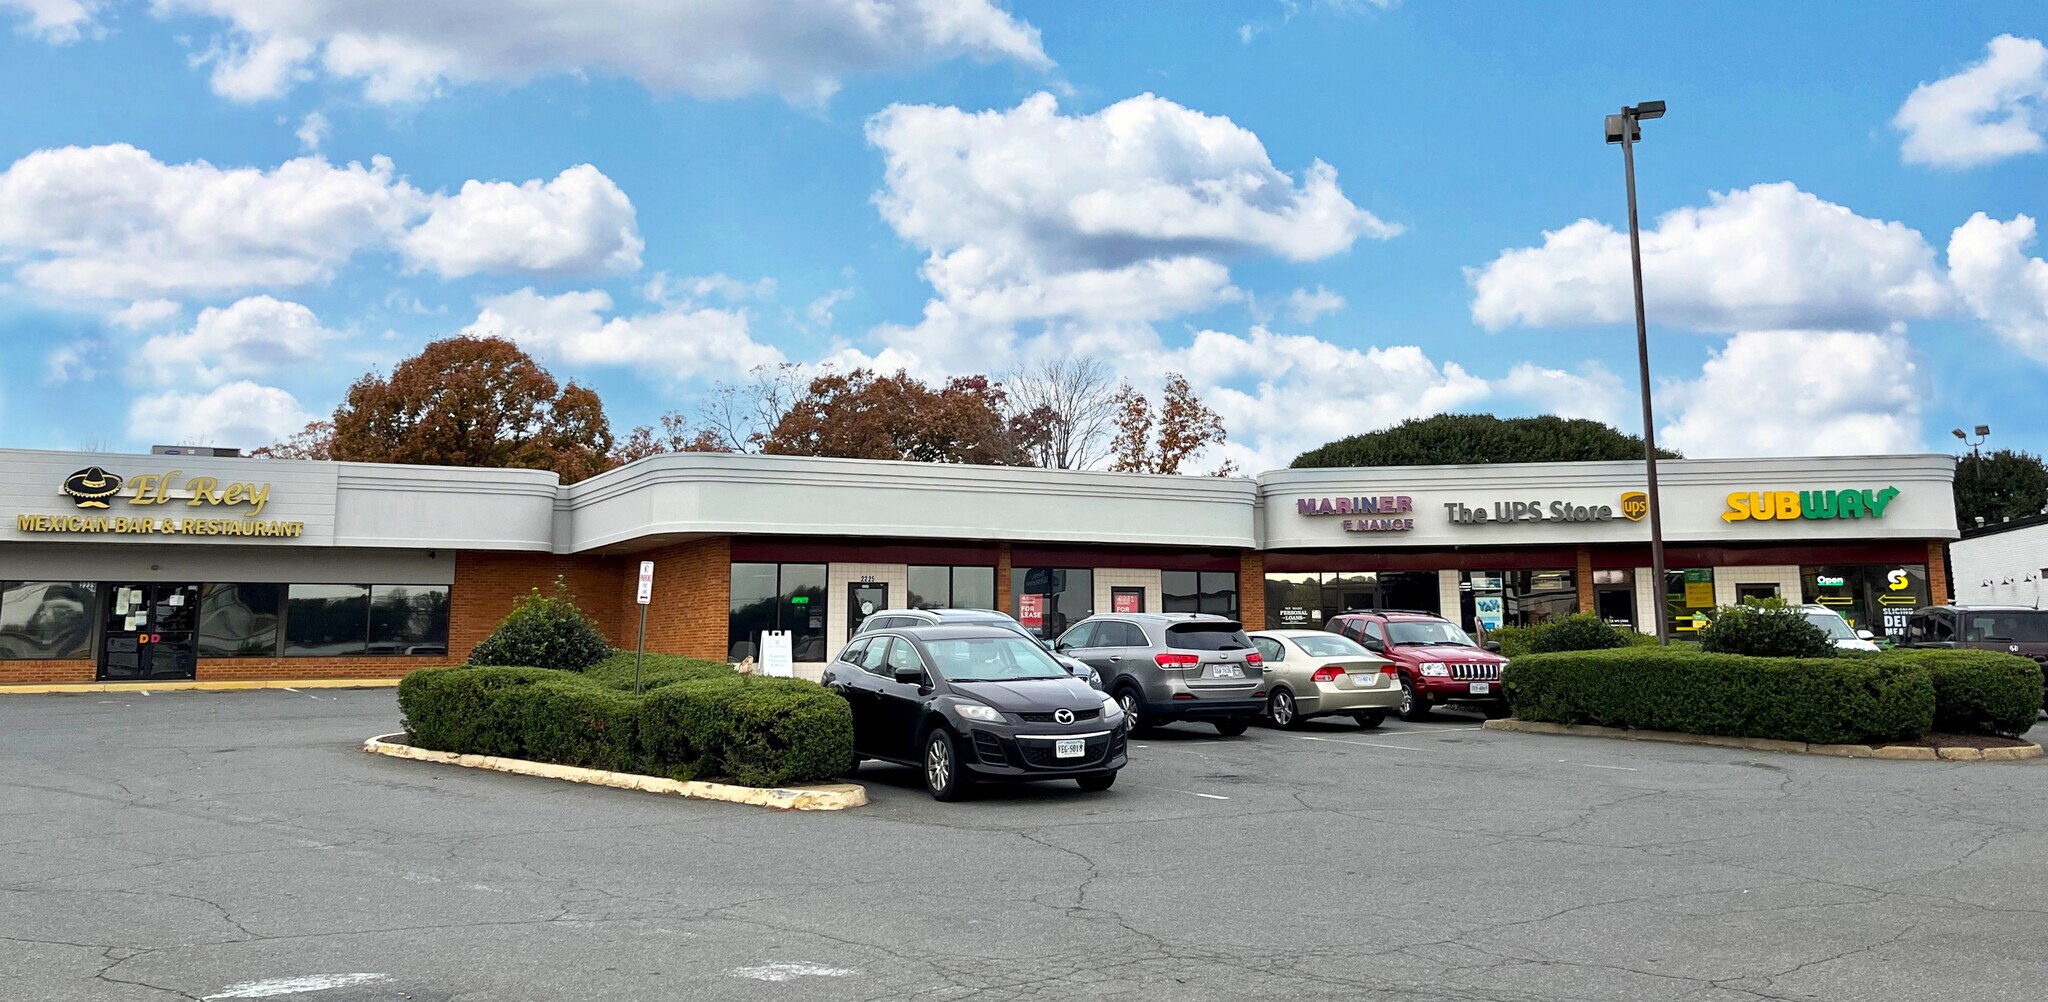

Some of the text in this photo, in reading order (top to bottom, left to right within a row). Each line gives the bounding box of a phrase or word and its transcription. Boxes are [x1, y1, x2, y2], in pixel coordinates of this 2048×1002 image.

[128, 470, 271, 517] El Rey
[1297, 496, 1413, 515] MARINER
[1444, 501, 1613, 524] The UPS Store
[1624, 501, 1646, 516] ups
[1720, 485, 1901, 524] SUBWAY
[17, 514, 304, 537] MEXICAN BAR & RESTAURANT
[1817, 575, 1844, 584] Open
[1884, 615, 1907, 627] DEL
